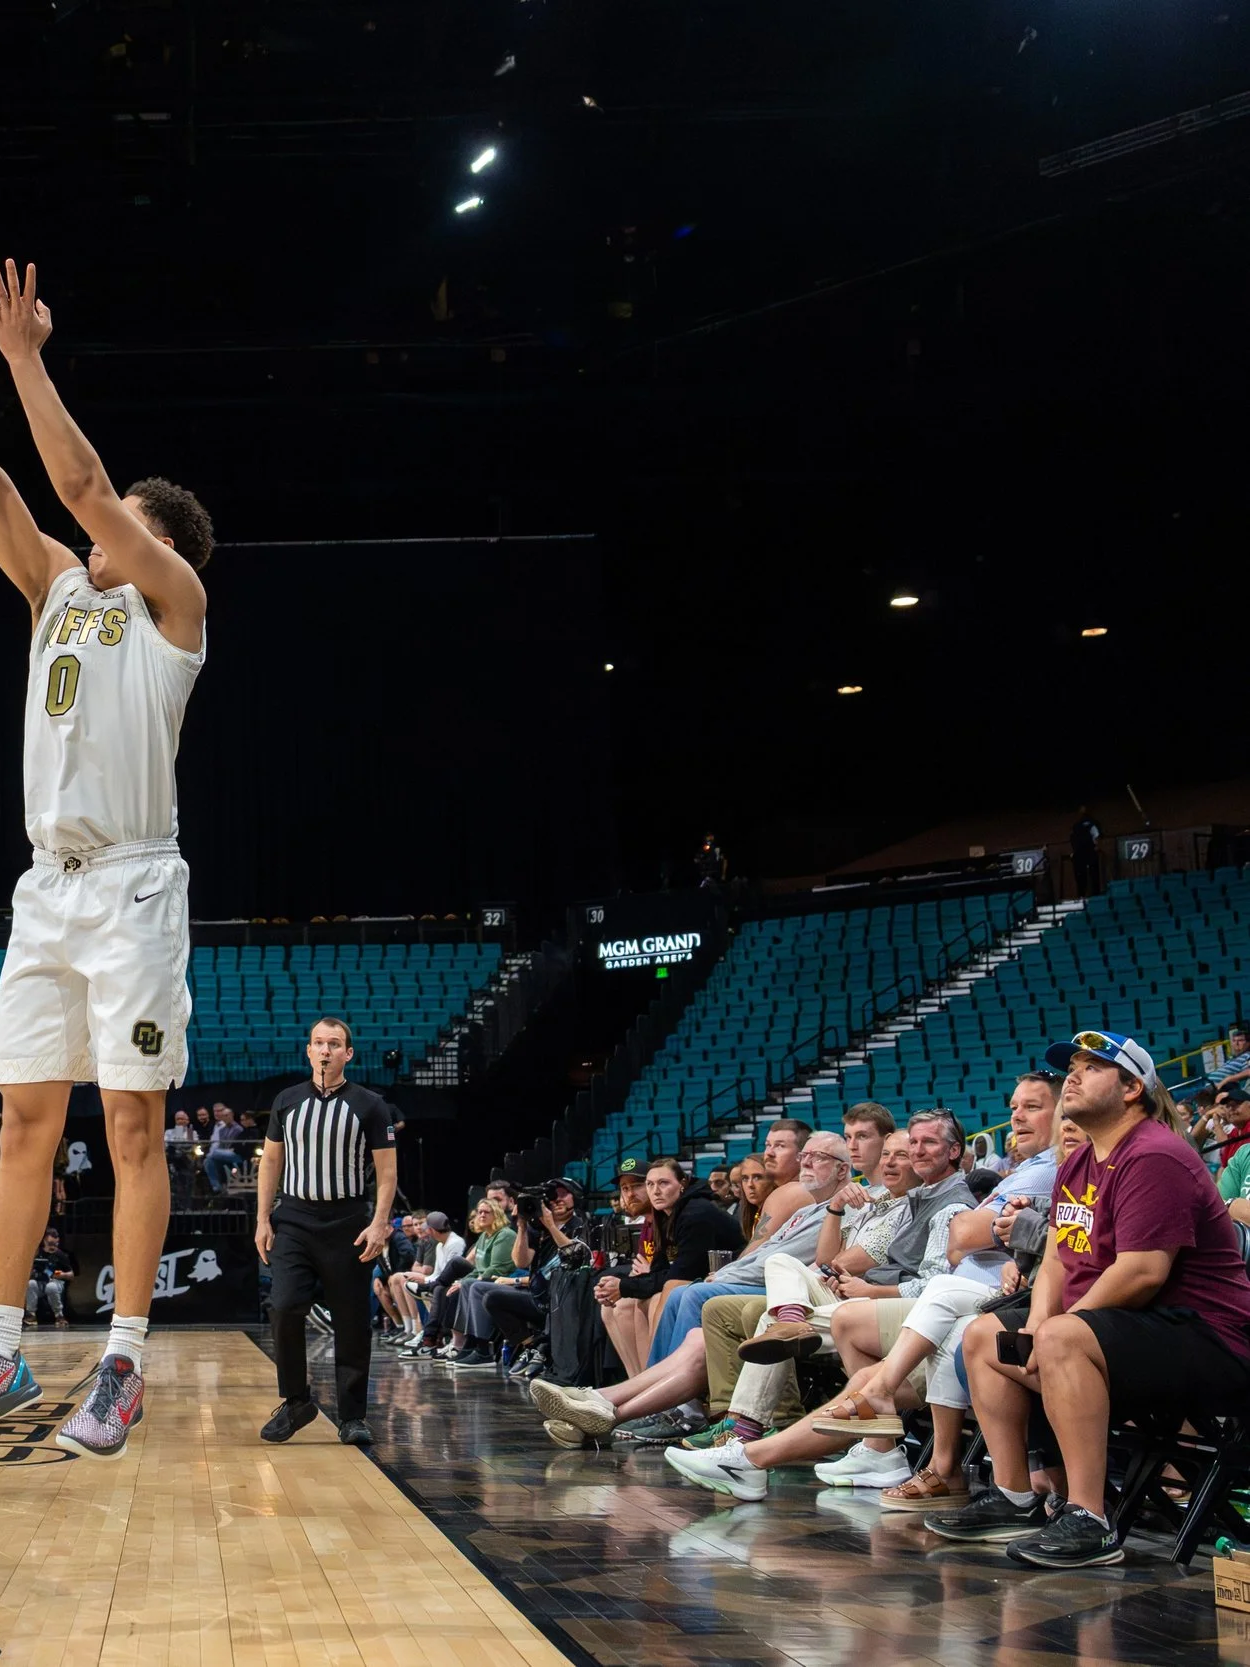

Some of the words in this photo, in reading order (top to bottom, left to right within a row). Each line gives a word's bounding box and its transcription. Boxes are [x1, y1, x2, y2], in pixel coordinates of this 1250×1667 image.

[45, 655, 81, 716] 0
[1131, 843, 1149, 860] 29
[1016, 858, 1033, 874] 30
[483, 912, 500, 926] 32
[590, 909, 604, 923] 30
[598, 939, 640, 958] MGM
[642, 933, 701, 953] GRAND
[605, 957, 651, 969] GARDEN
[96, 1248, 195, 1314] GST
